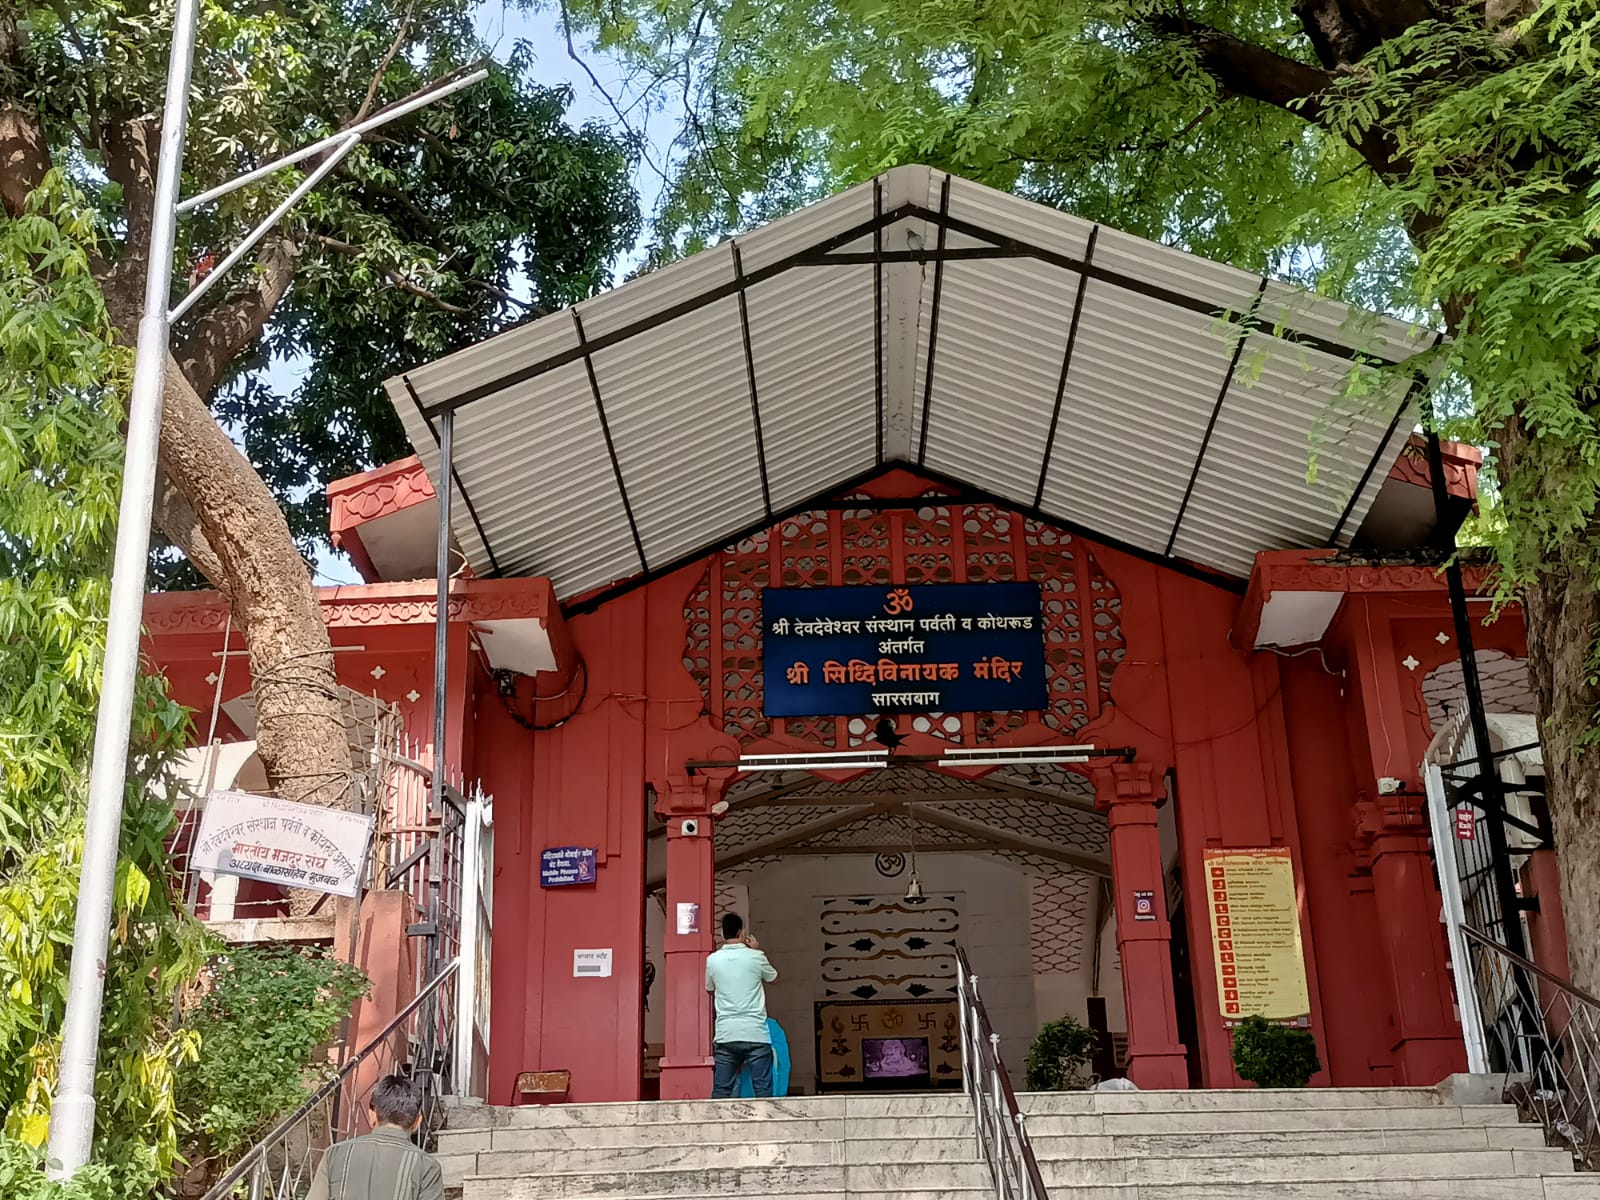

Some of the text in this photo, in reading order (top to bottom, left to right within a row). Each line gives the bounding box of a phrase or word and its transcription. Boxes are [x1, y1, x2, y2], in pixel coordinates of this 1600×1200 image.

[882, 588, 915, 616] ॐ
[771, 615, 790, 636] श्री
[794, 617, 861, 636] देवदेवेश्वर
[865, 615, 915, 634] संस्थान
[920, 614, 956, 633] पर्वती
[961, 617, 972, 631] व
[878, 637, 925, 655] अंतर्गत
[785, 661, 810, 685] श्री
[973, 656, 1024, 684] मंदिर
[871, 690, 940, 707] सारसबाग
[246, 816, 278, 833] संस्थान
[280, 816, 303, 834] पर्वती
[303, 825, 311, 838] व
[231, 840, 271, 860] भारतीय
[305, 852, 328, 870] संघ
